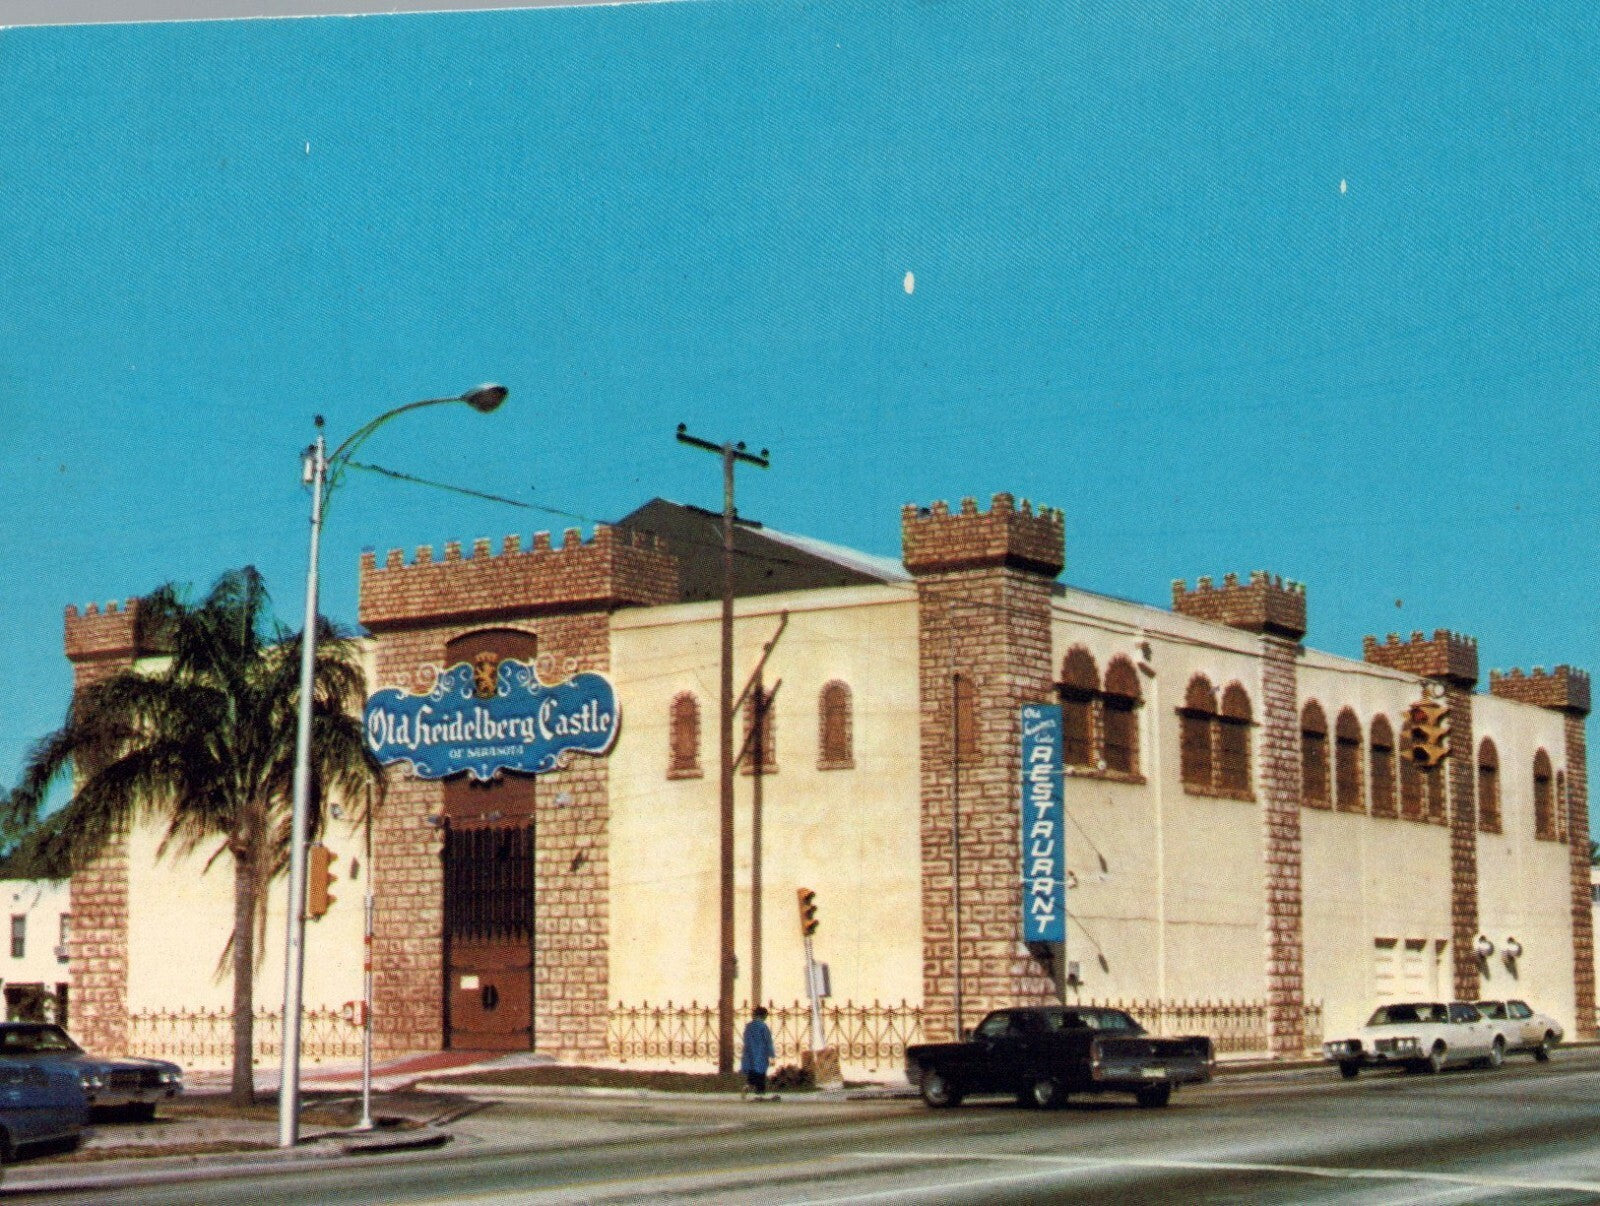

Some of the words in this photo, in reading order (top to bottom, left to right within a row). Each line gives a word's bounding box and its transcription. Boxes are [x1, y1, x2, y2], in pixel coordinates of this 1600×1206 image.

[367, 706, 410, 752] Old
[409, 703, 535, 750] Heidelberg
[538, 697, 611, 741] Castle
[1029, 745, 1056, 934] RESTAURANT
